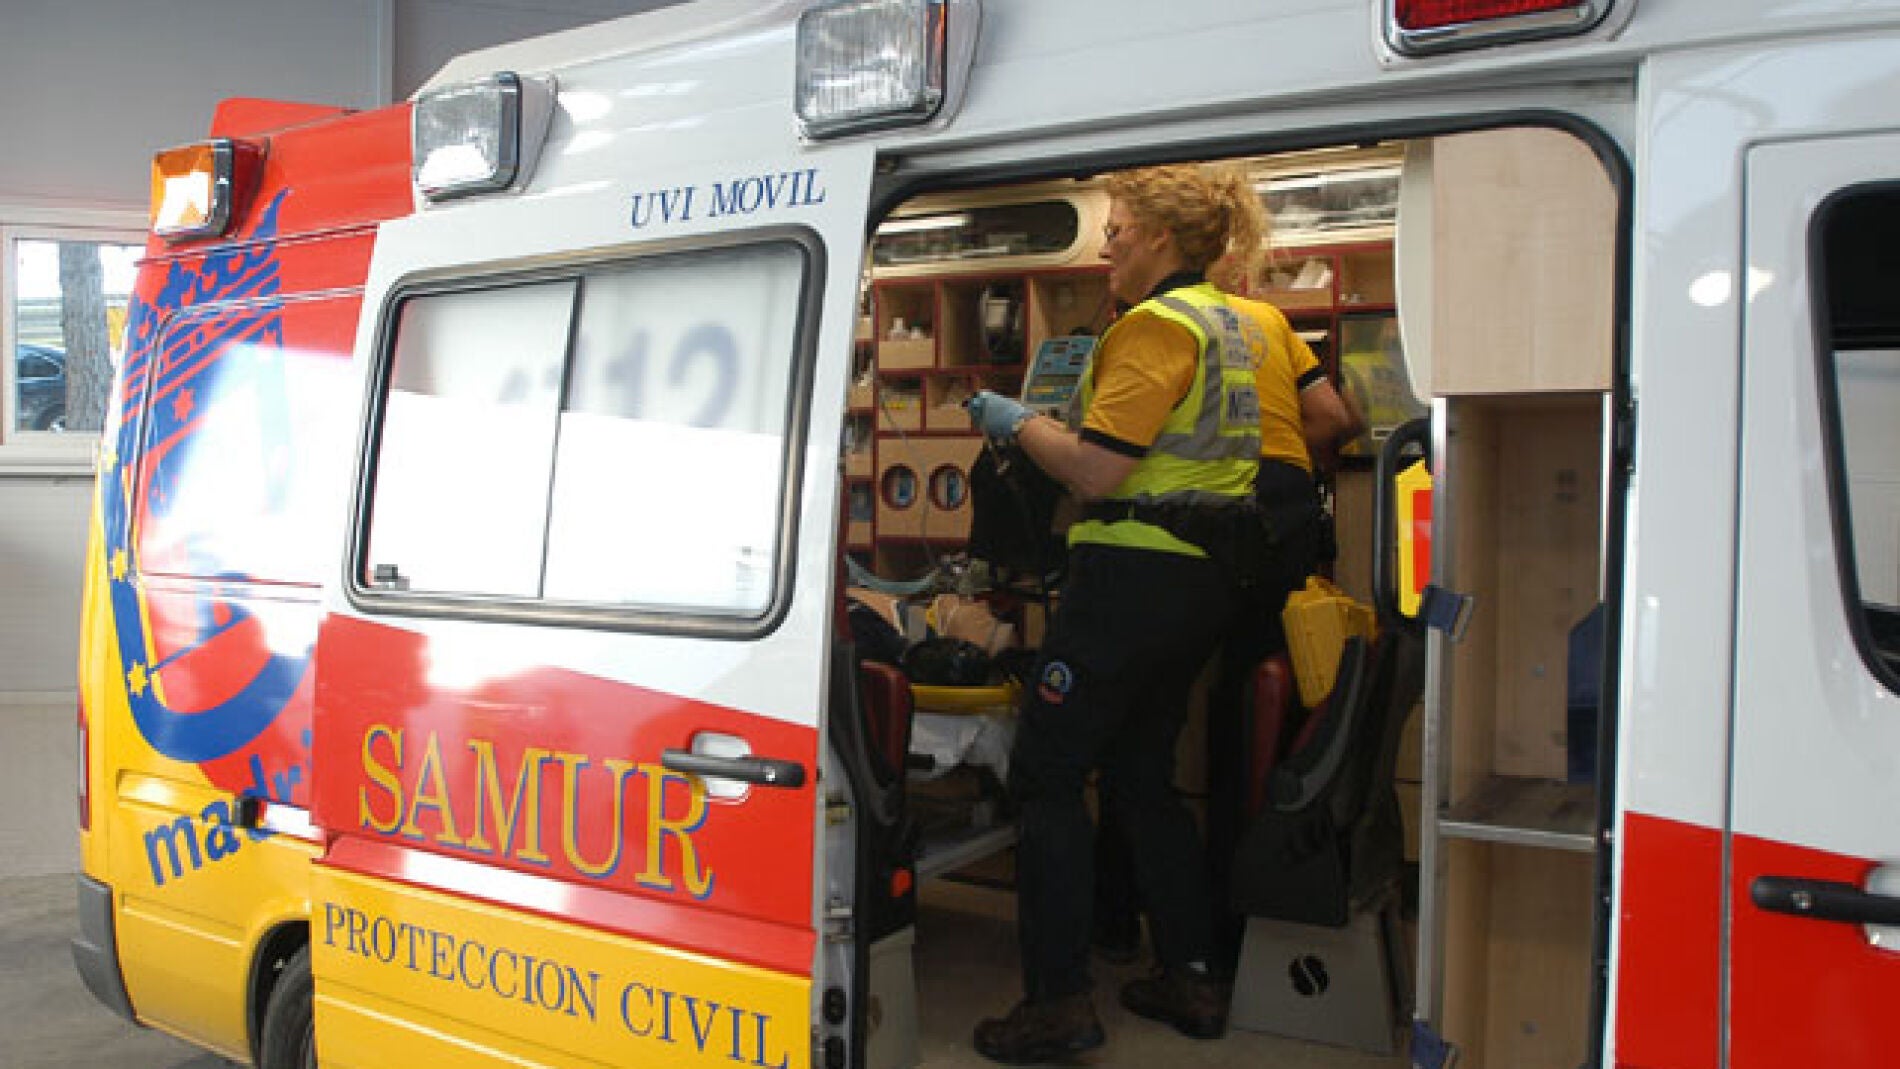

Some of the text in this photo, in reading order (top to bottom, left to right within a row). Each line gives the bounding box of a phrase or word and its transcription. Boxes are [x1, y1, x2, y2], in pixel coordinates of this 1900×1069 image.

[630, 168, 827, 230] UVI MOVIL
[359, 723, 716, 901] SAMUR
[324, 902, 790, 1069] PROTECCION CIVIL
